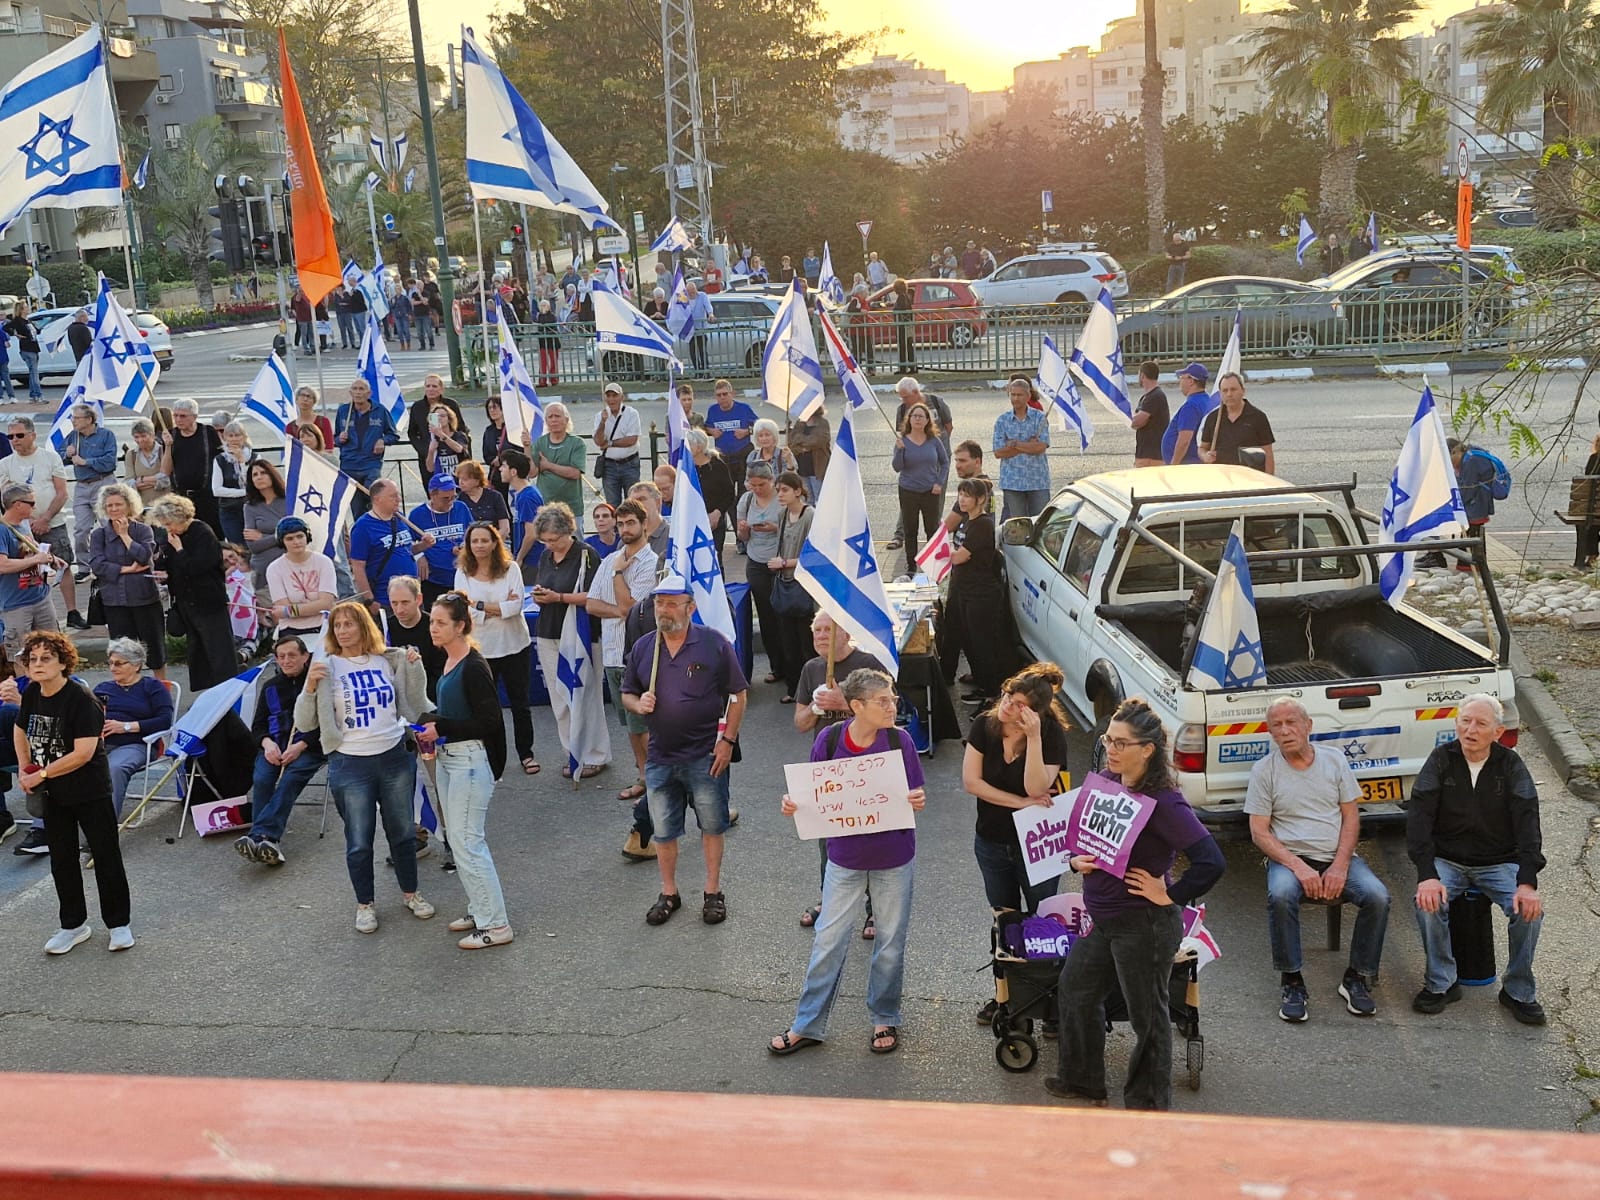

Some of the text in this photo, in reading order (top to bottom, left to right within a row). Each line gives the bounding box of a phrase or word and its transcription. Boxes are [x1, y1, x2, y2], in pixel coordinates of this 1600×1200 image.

[348, 669, 387, 688] דמו
[353, 685, 393, 708] קרט
[355, 706, 375, 727] יה
[1221, 707, 1267, 717] MITSUBISH
[1221, 742, 1267, 756] נאמנים
[828, 811, 880, 828] ומוסרי
